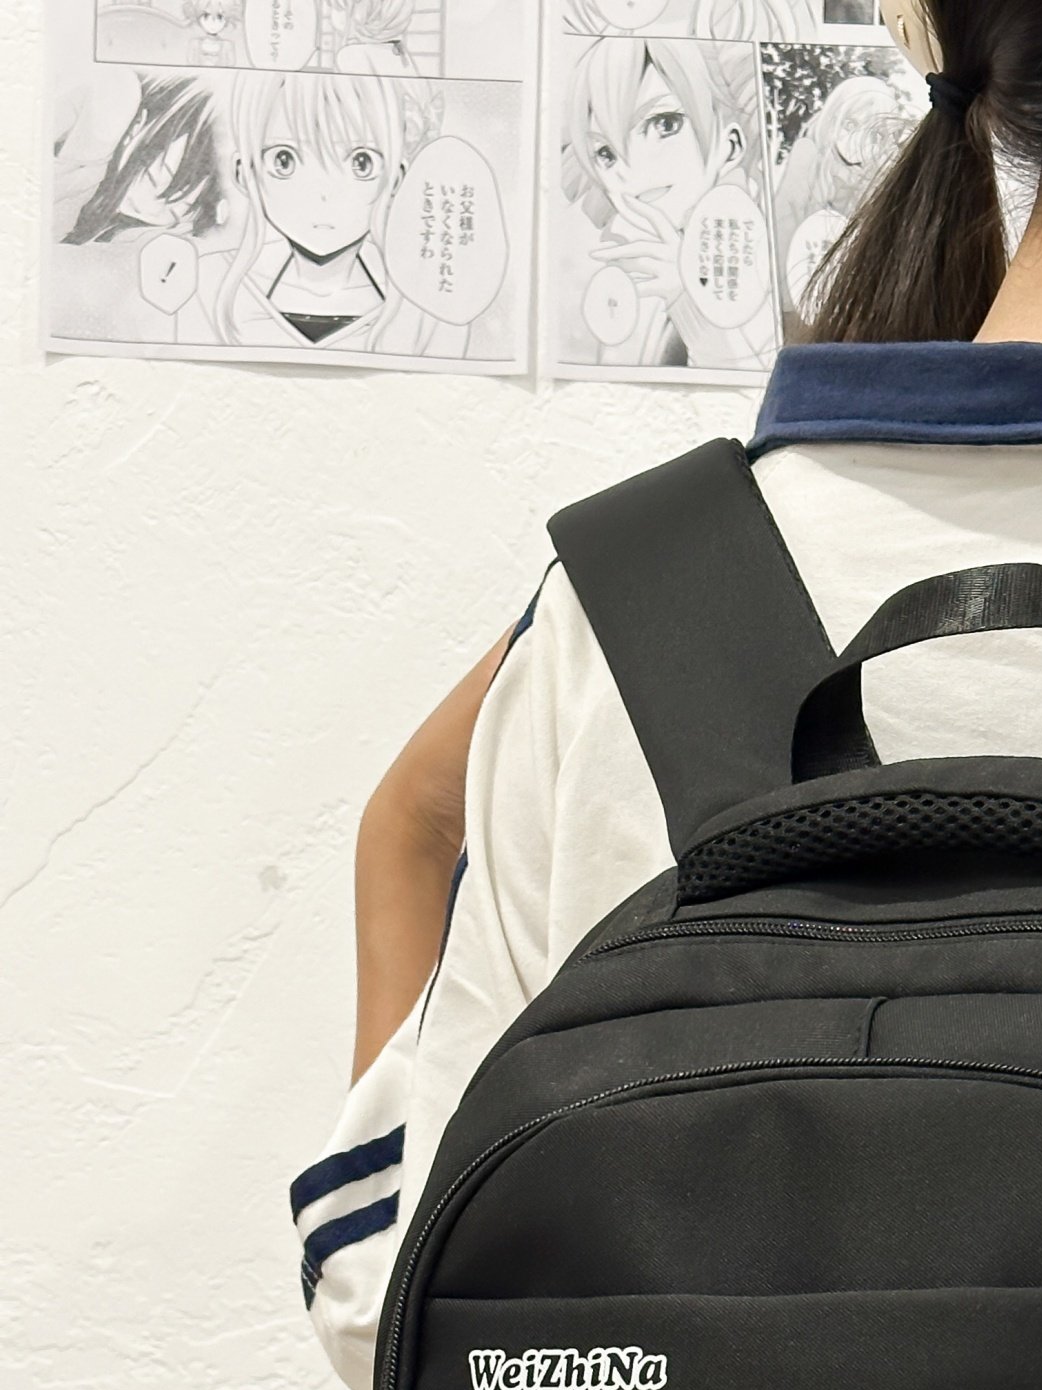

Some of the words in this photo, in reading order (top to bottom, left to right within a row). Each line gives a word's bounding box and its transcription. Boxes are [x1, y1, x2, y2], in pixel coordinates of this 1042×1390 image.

[420, 181, 436, 259] ときですわ
[439, 185, 456, 293] いなくなられた
